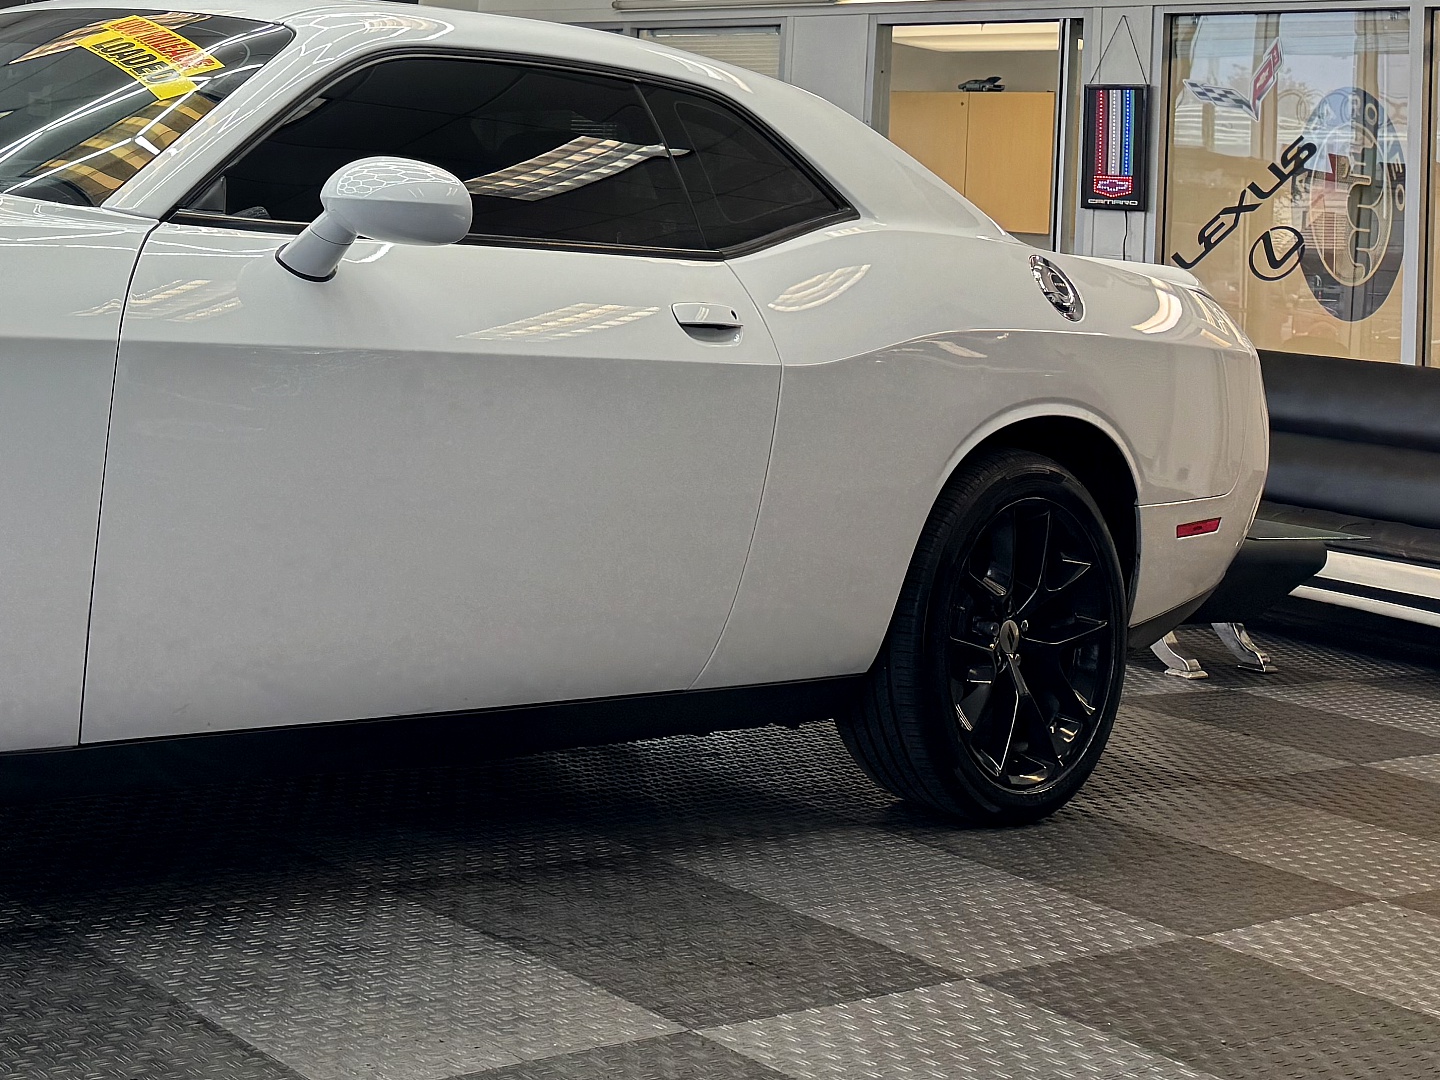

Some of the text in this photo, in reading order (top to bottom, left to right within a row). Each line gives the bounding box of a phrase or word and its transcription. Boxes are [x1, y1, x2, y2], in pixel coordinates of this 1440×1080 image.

[89, 37, 182, 85] LOADED
[1088, 198, 1139, 207] CAMARO
[1171, 135, 1318, 270] LEXUS
